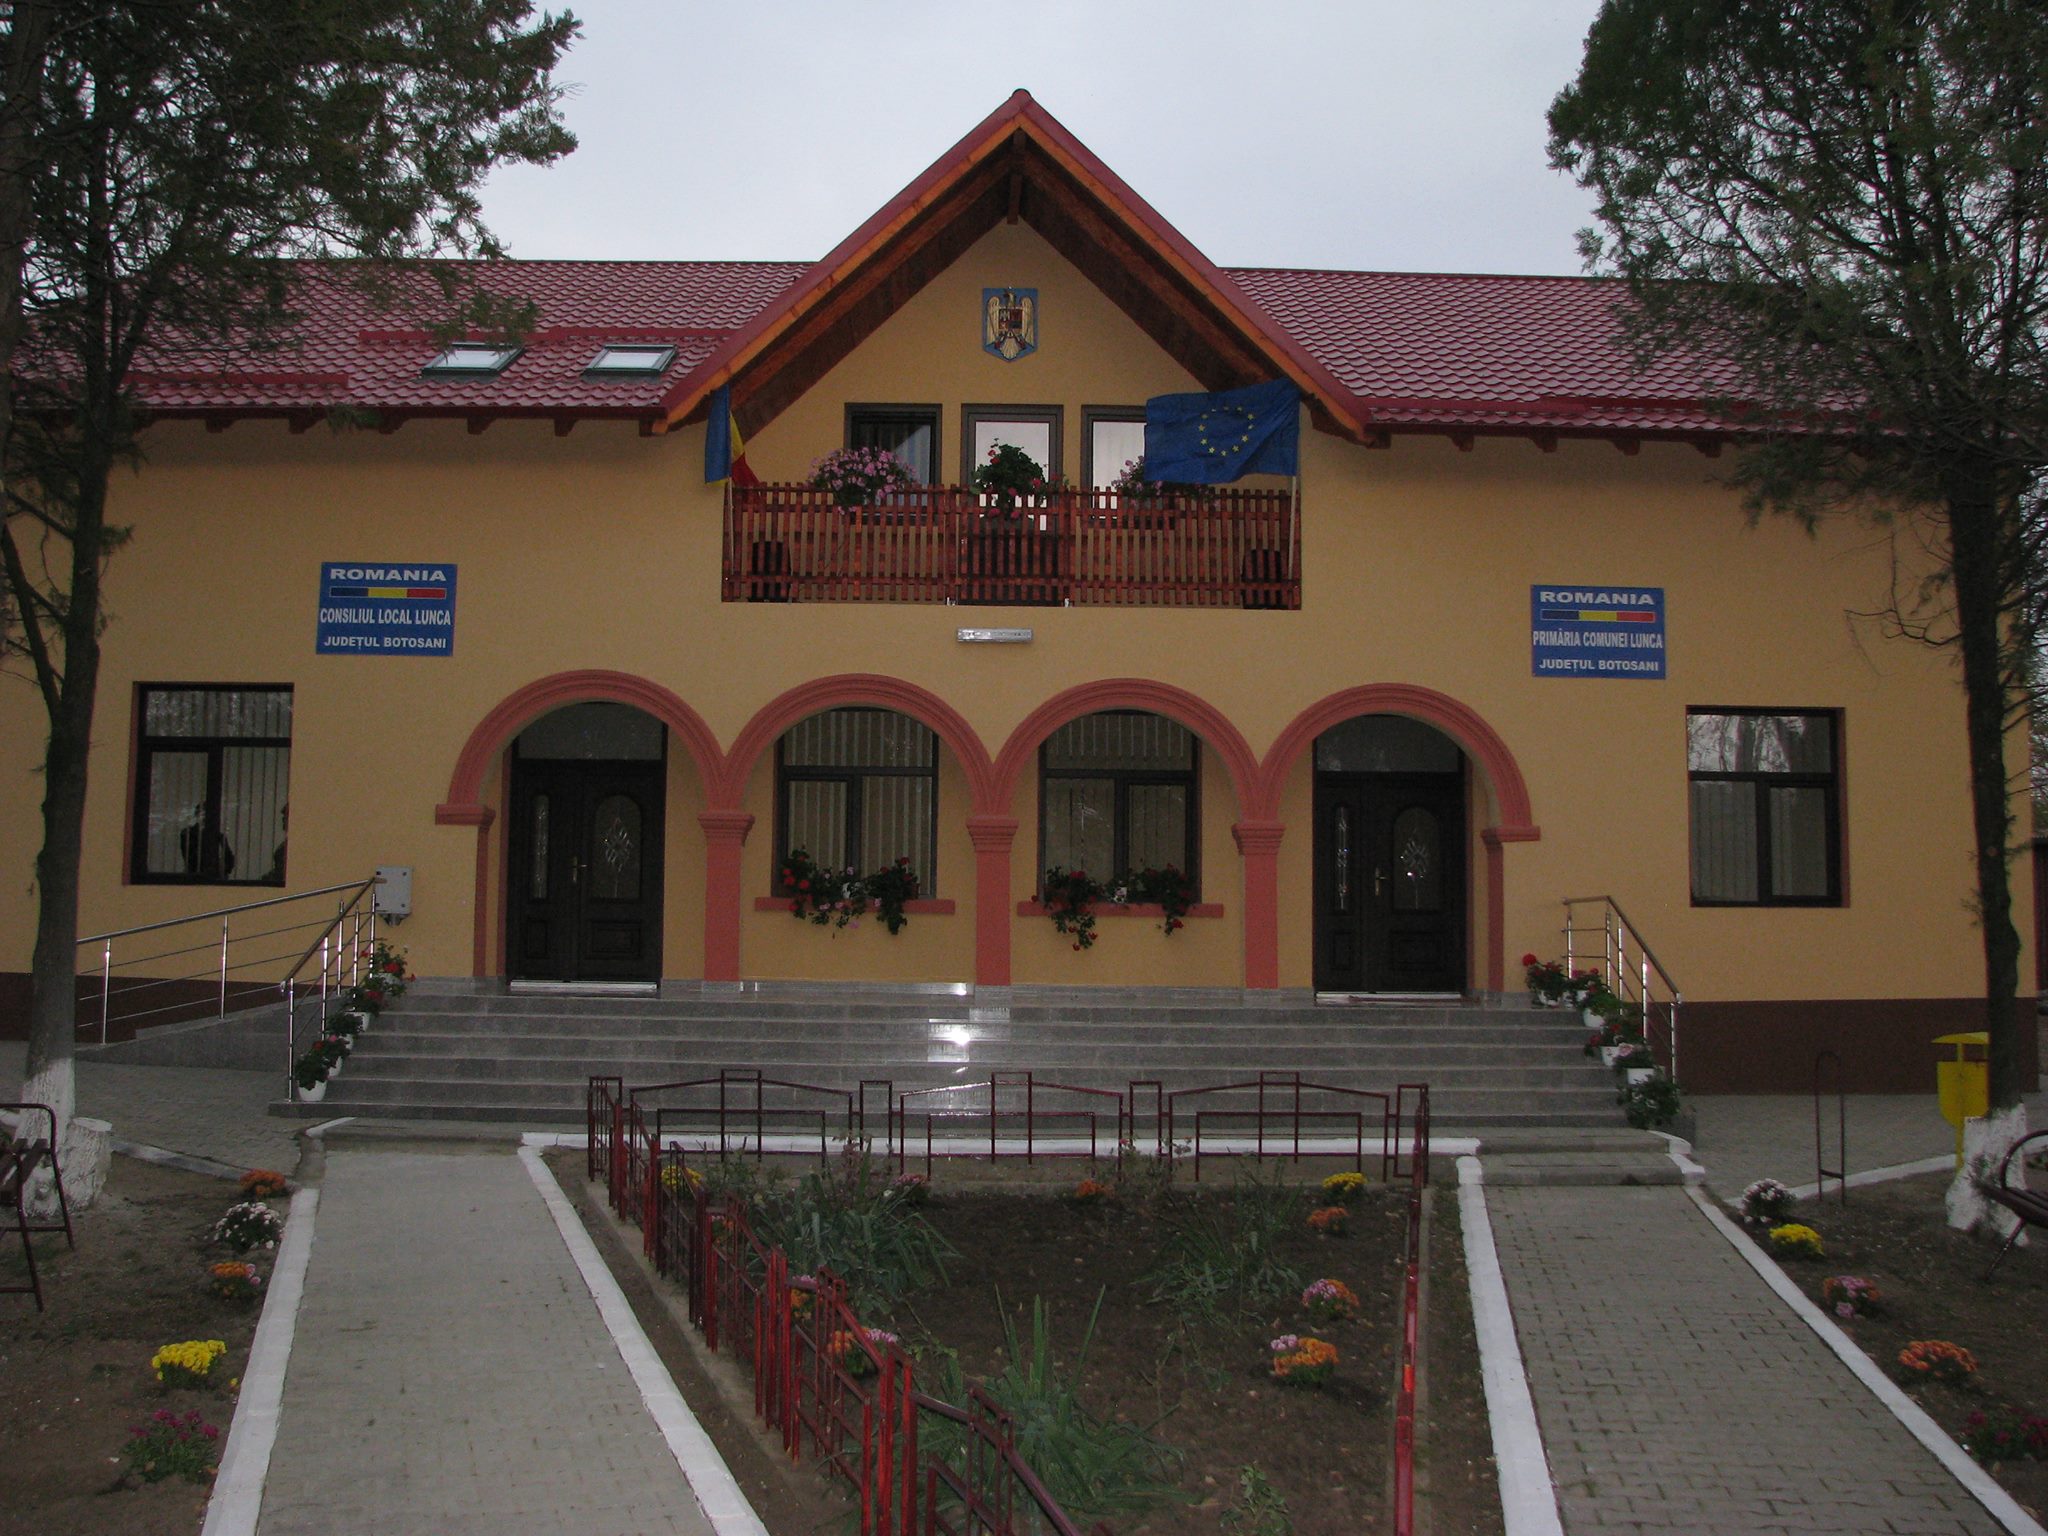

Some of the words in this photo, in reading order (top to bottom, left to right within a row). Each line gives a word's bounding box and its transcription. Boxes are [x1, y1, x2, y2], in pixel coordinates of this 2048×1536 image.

[330, 568, 447, 581] ROMANIA
[1540, 591, 1654, 605] ROMANIA
[320, 608, 375, 624] CONSILIUL
[378, 609, 412, 625] LOCAL
[415, 610, 451, 626] LUNCA
[383, 637, 447, 649] BOTOSANI
[1583, 632, 1628, 648] COMUNEI
[1630, 633, 1663, 649] LUNCA
[1598, 660, 1659, 671] BOTOSANI
